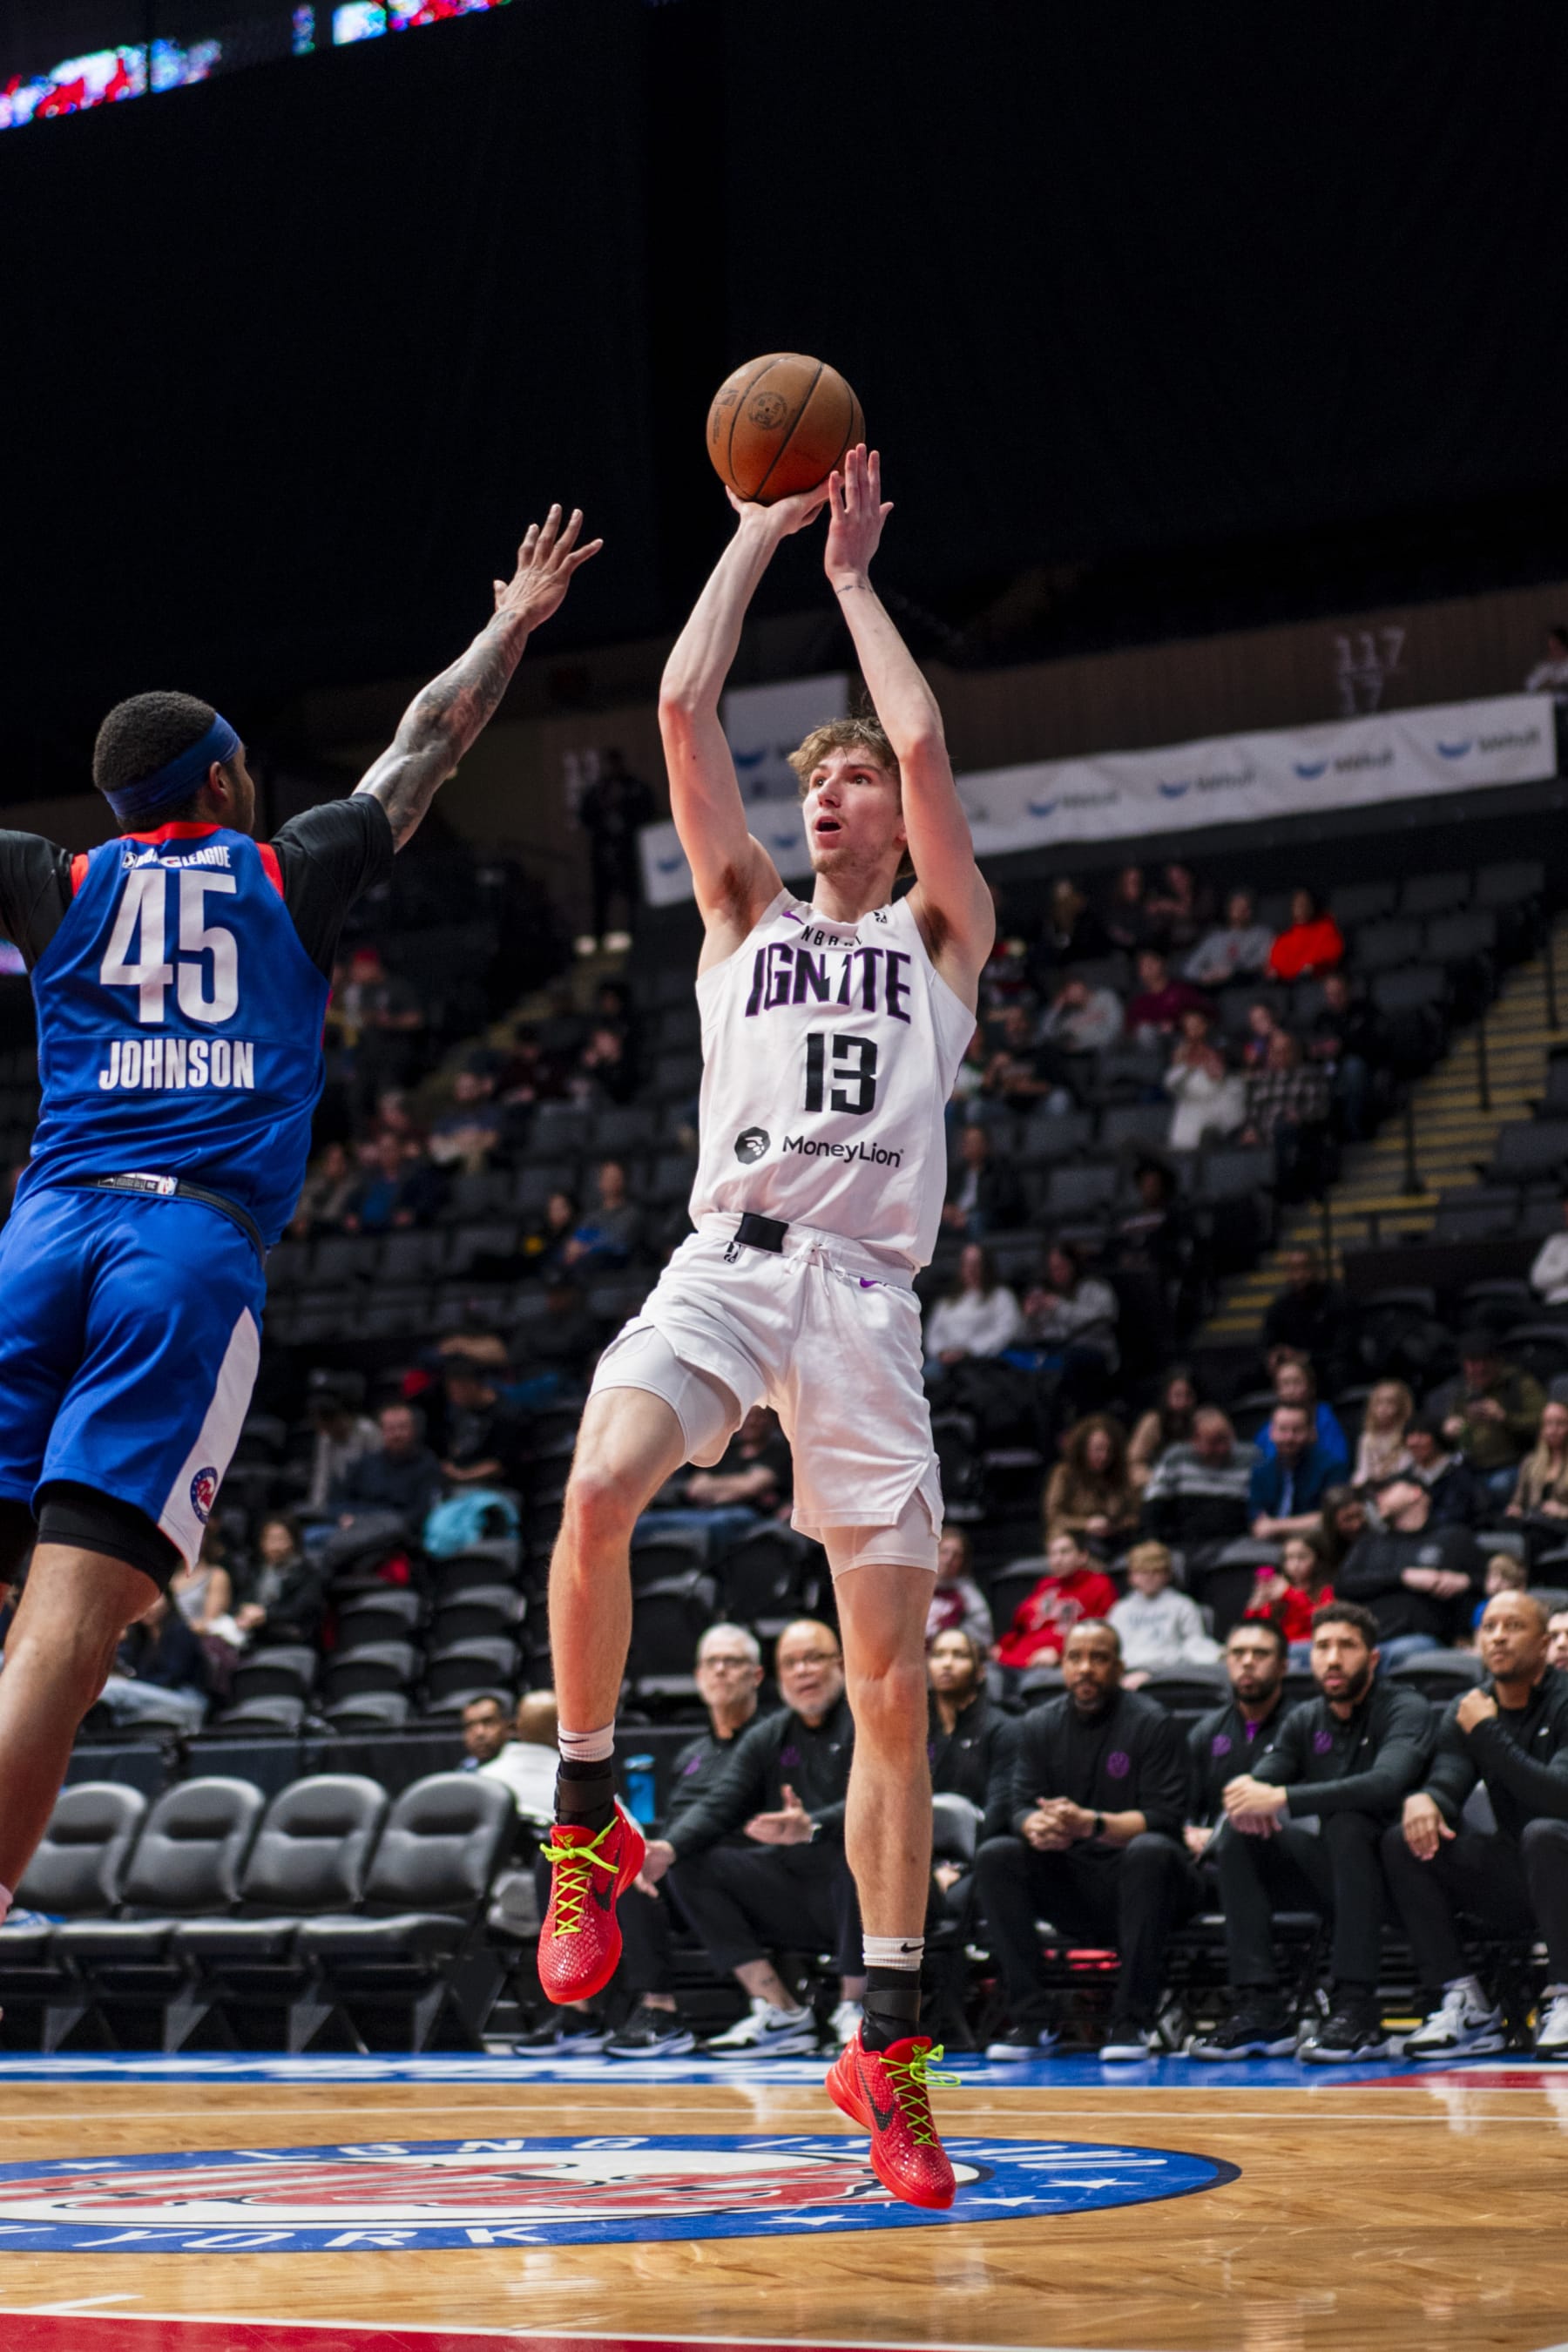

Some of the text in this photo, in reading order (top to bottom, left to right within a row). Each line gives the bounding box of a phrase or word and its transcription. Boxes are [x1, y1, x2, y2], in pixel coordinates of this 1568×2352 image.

[183, 845, 232, 868] LEAGUE
[100, 868, 239, 1024] 45
[745, 942, 911, 1024] IGNITE
[98, 1038, 254, 1091] JOHNSON
[805, 1032, 878, 1115] 13
[782, 1135, 901, 1168] MoneyLion
[233, 2137, 651, 2160] LONG
[73, 2226, 549, 2249] YORK
